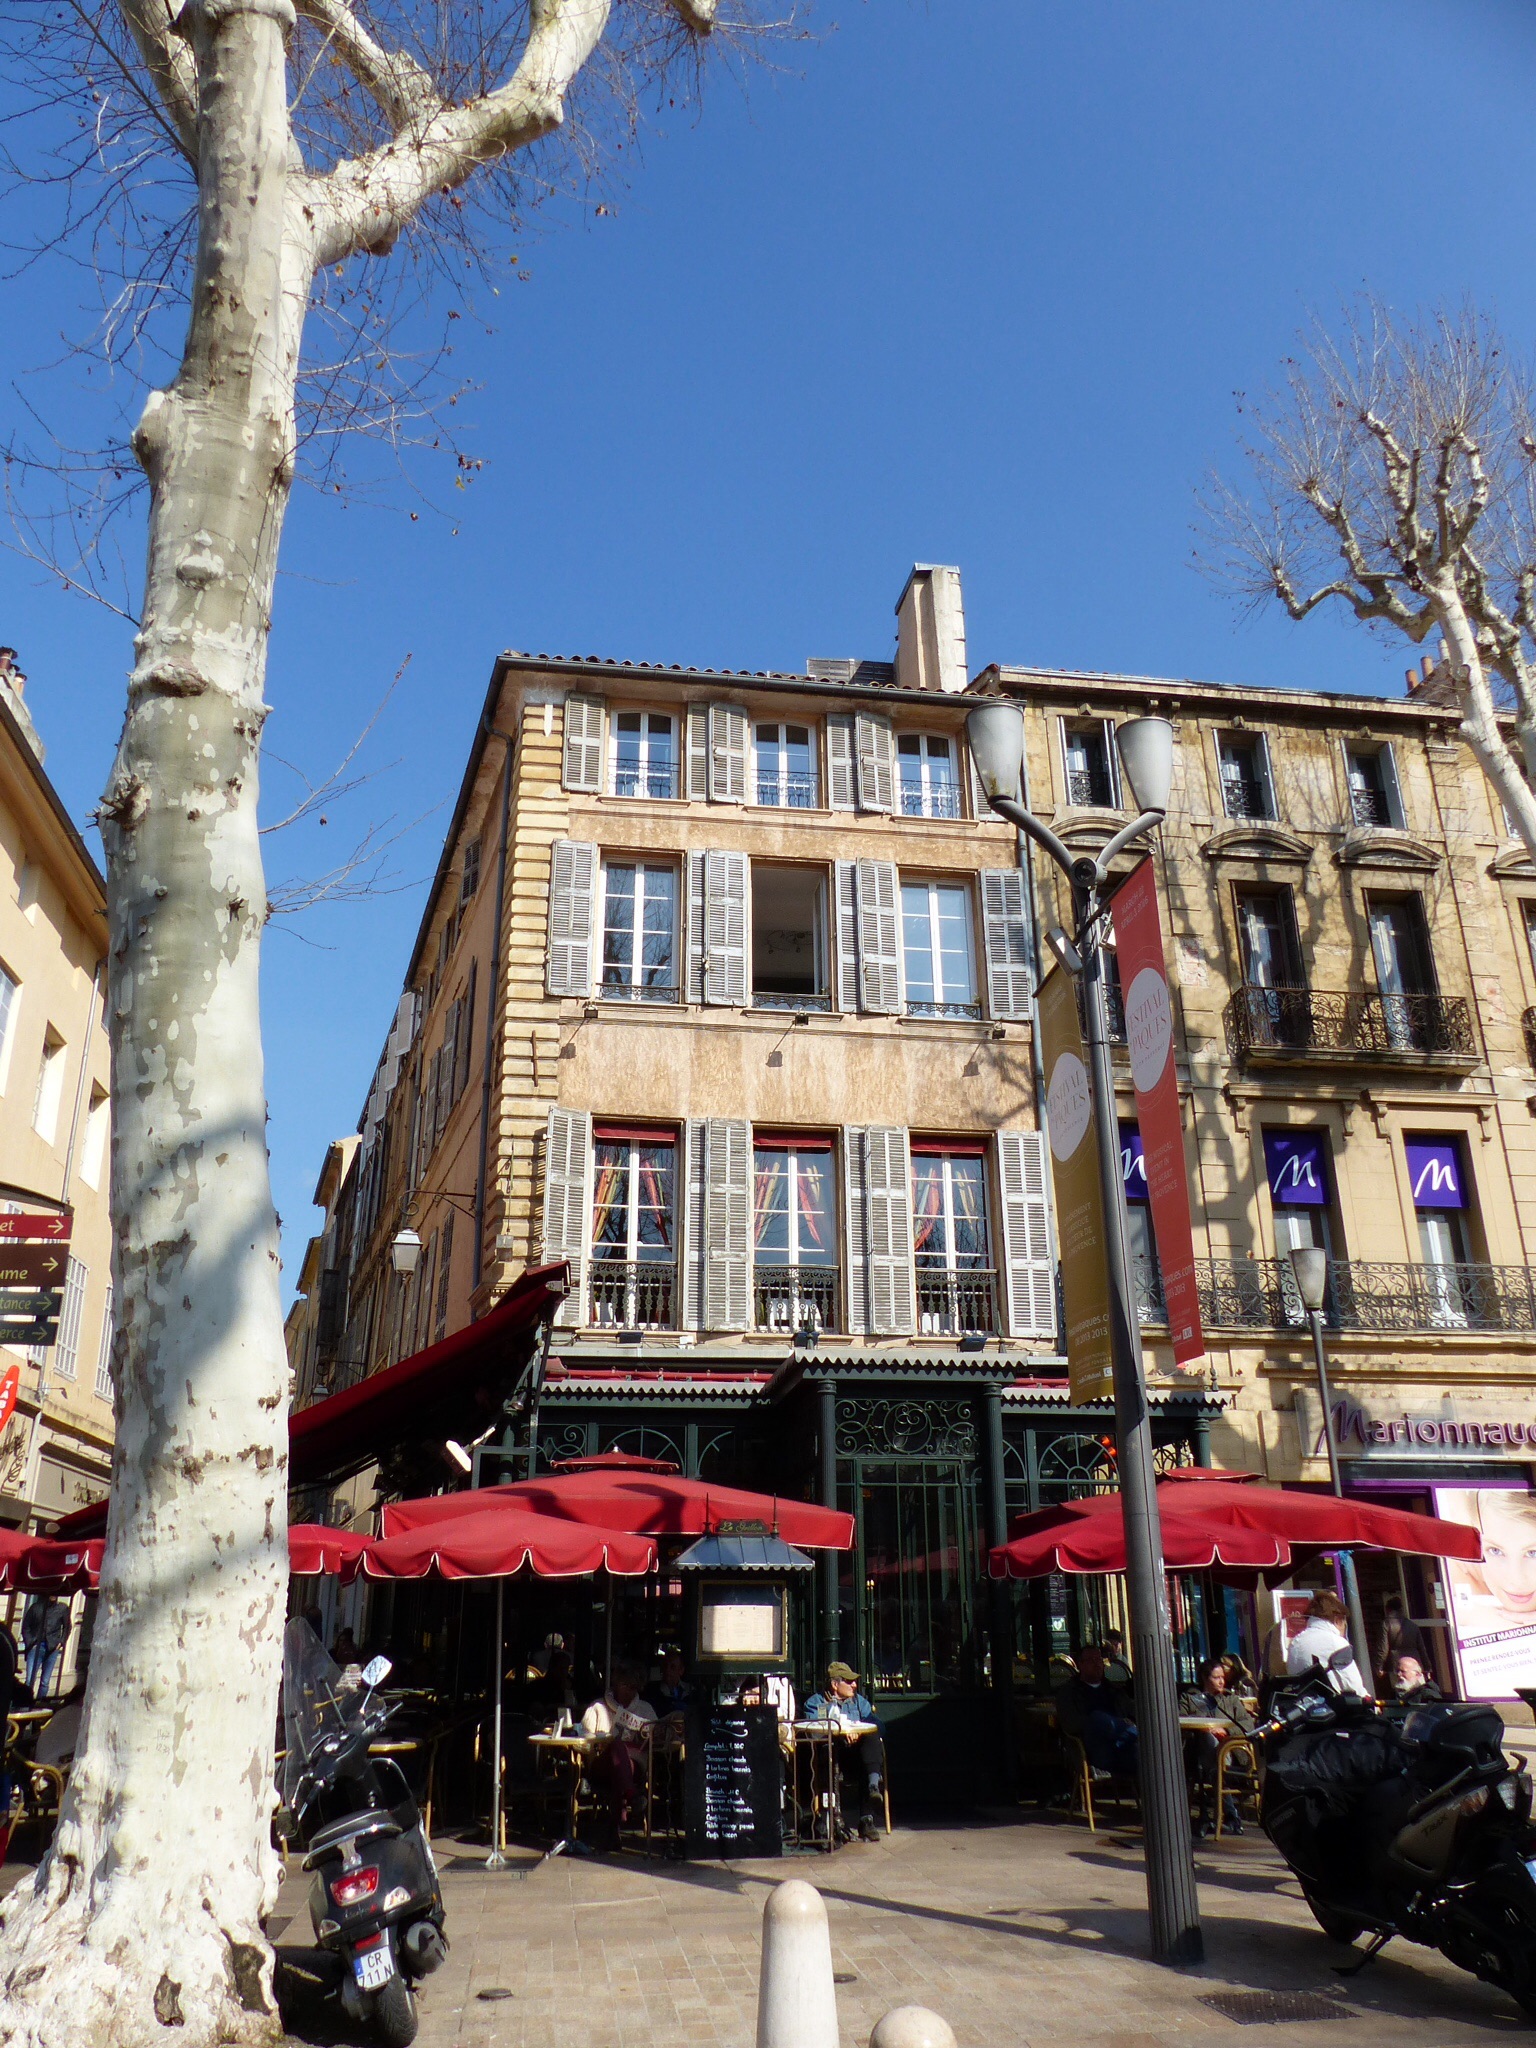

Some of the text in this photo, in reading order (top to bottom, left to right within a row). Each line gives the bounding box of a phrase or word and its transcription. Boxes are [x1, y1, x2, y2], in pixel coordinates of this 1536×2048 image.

[1463, 1634, 1497, 1648] INSTITUT
[1470, 1656, 1491, 1665] PRENEZ
[367, 1952, 383, 1968] CR
[358, 1969, 381, 1987] 711
